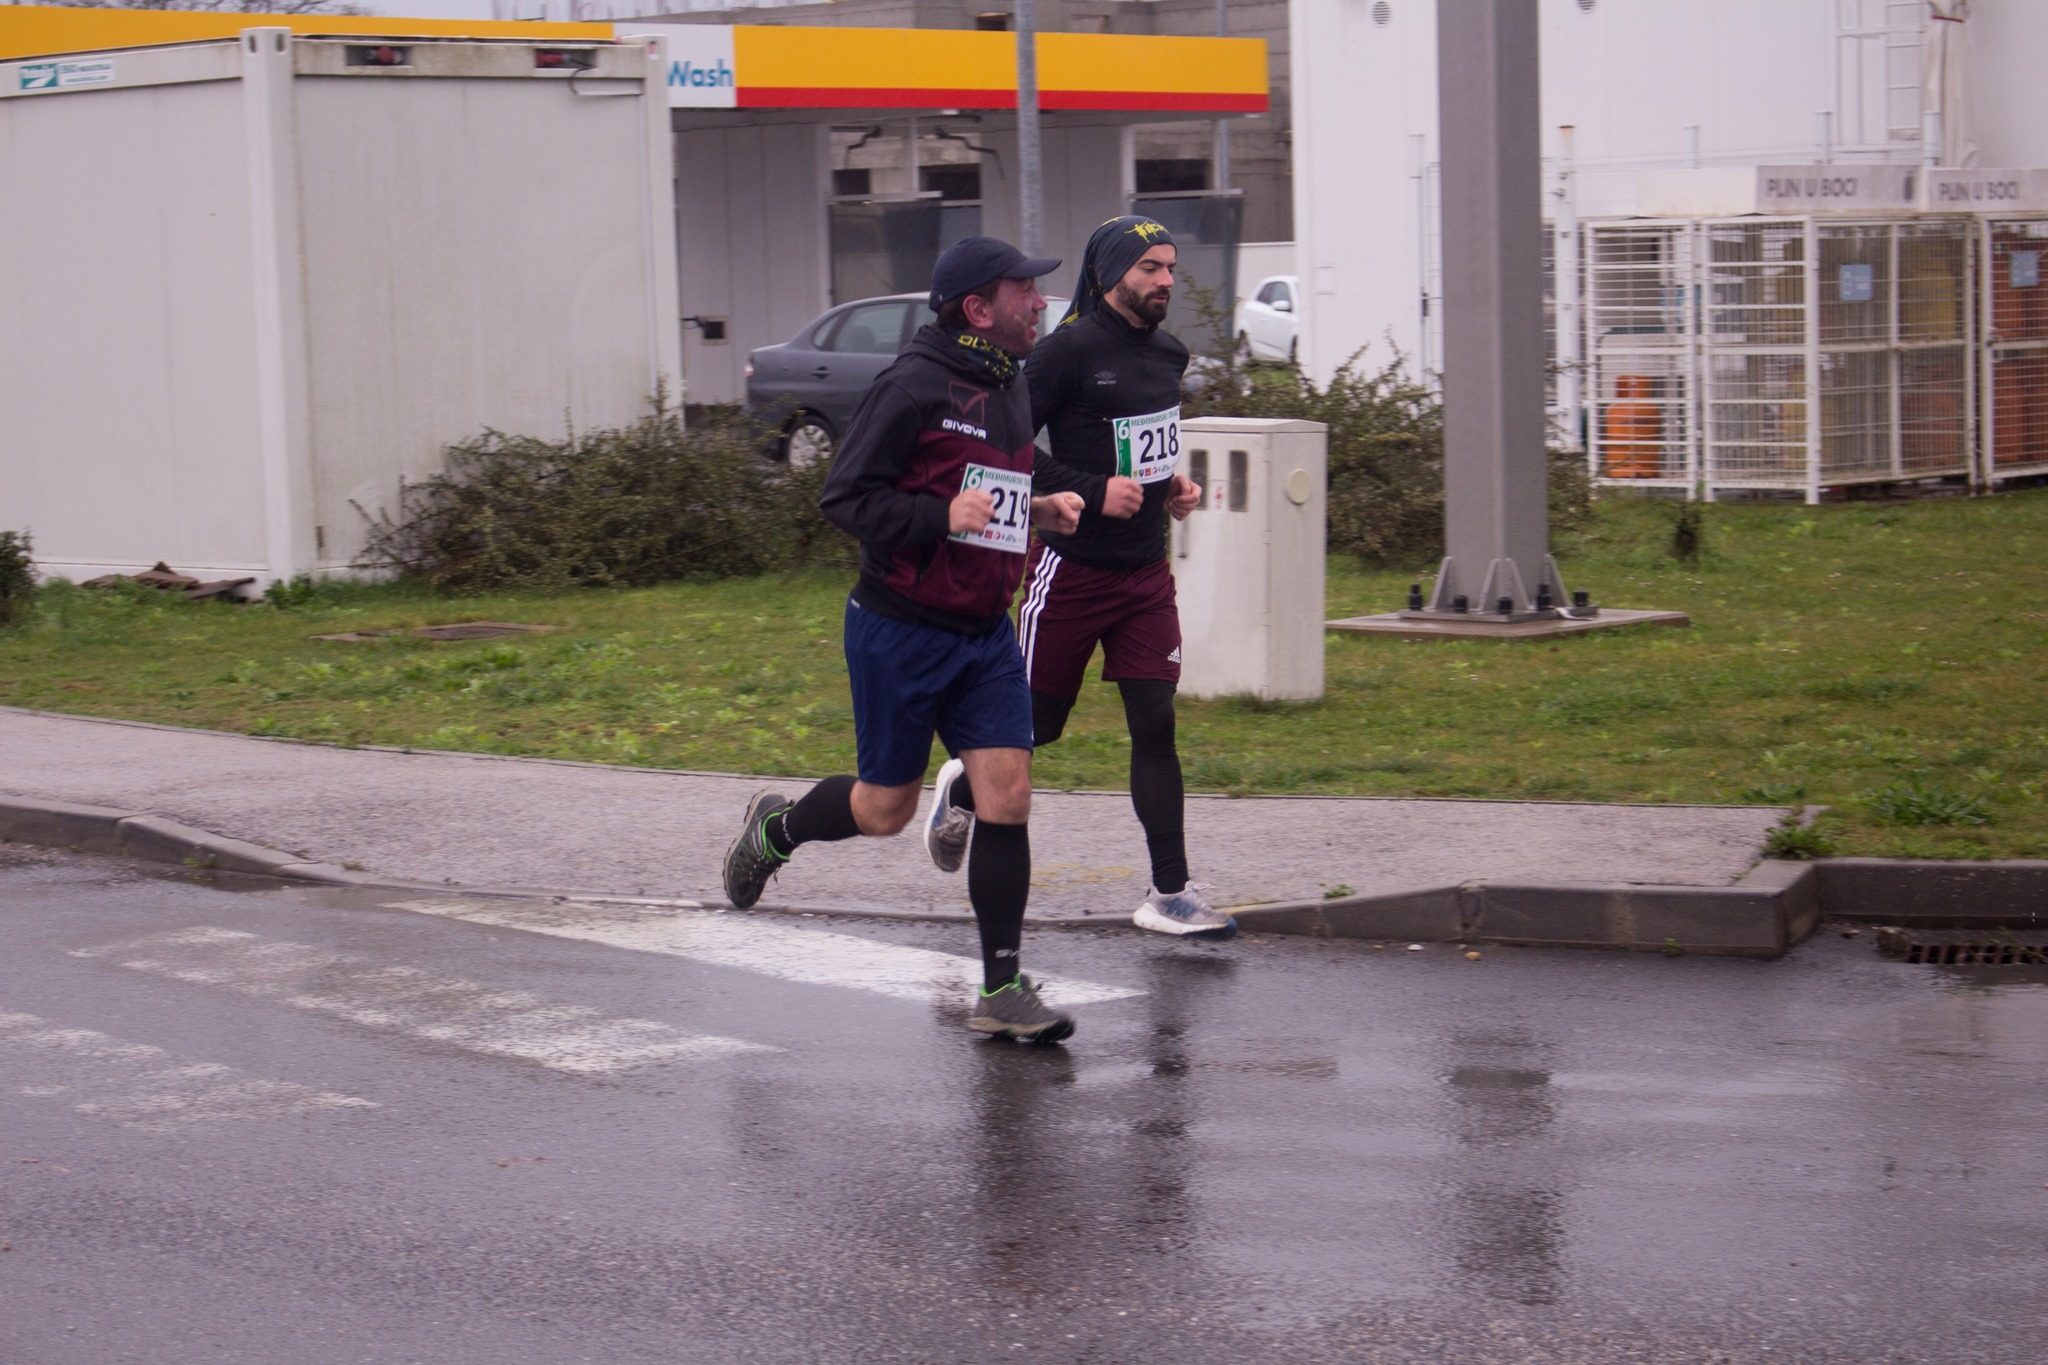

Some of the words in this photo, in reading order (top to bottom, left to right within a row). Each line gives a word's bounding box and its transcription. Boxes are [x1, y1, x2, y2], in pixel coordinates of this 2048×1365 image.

[667, 58, 733, 87] Wash
[1766, 177, 1801, 198] PLIN
[1804, 177, 1817, 198] U
[1939, 182, 1969, 201] PLIN
[1972, 182, 1984, 201] U
[942, 418, 987, 439] GIVOVA
[1139, 422, 1179, 464] 218
[989, 486, 1028, 530] 219
